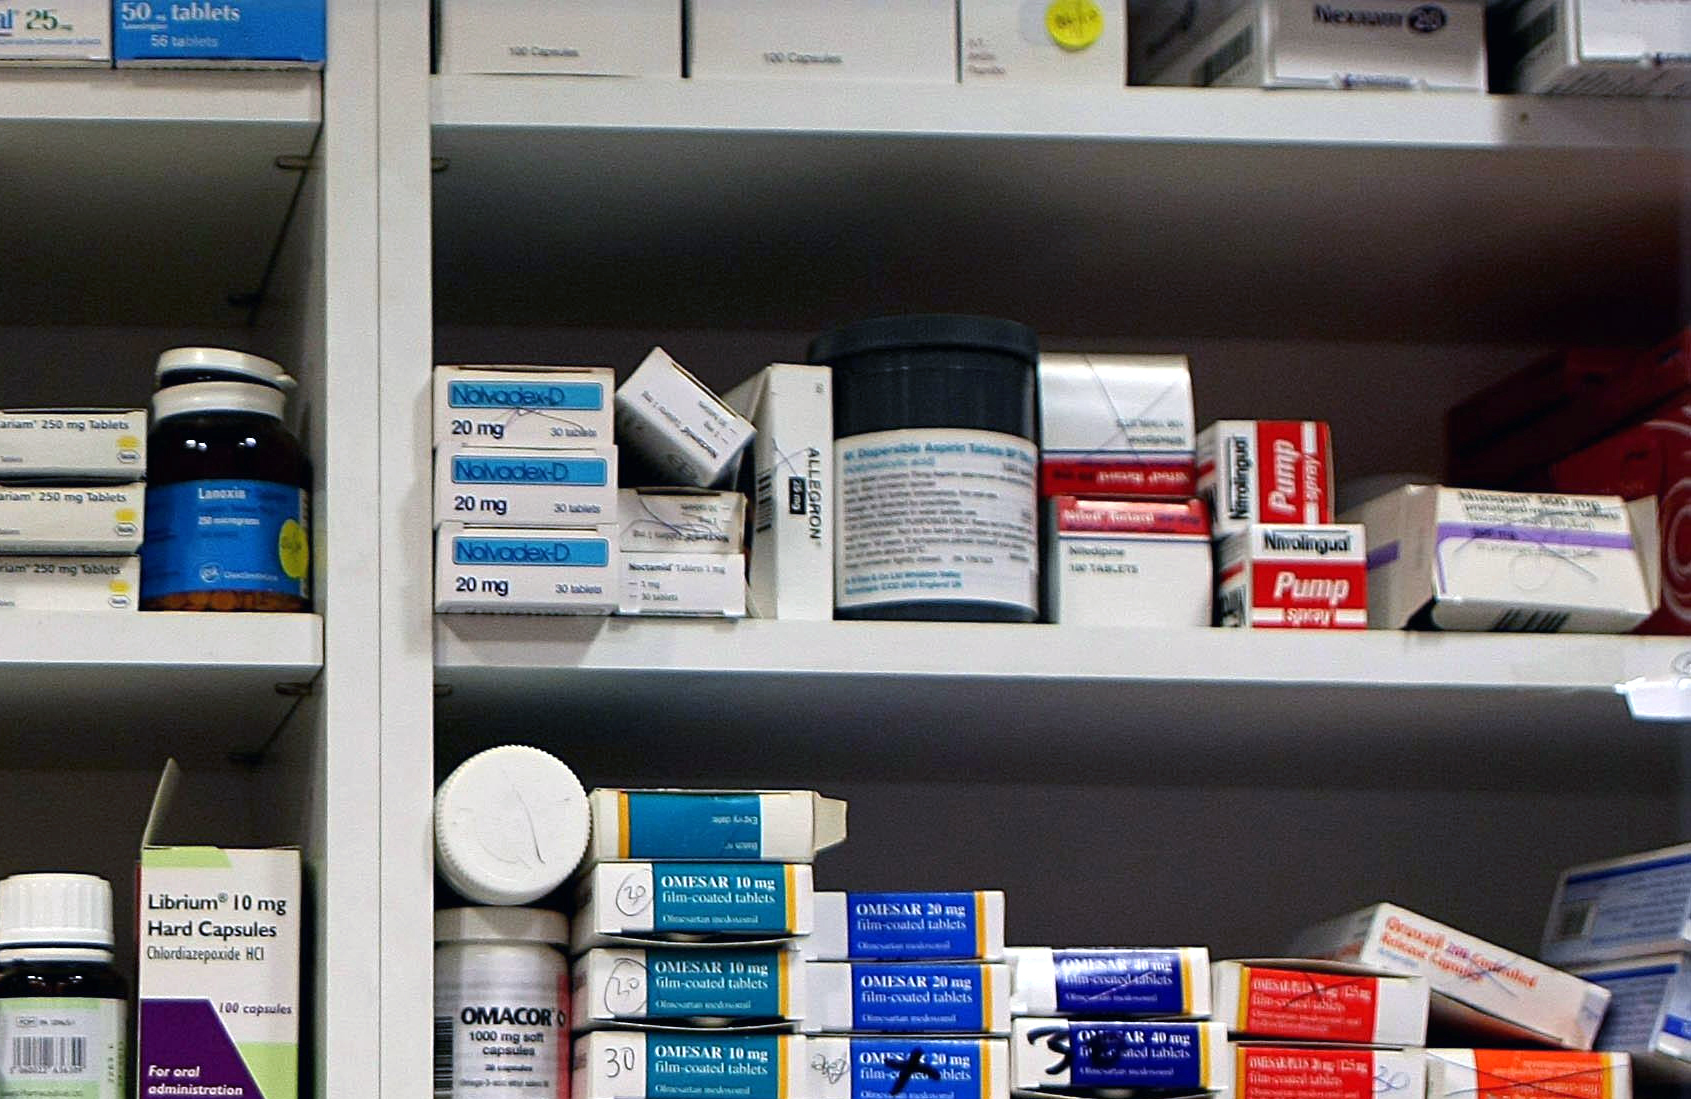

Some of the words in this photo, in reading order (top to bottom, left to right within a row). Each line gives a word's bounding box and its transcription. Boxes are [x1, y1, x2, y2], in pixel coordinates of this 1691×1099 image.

[122, 4, 152, 20] 50
[172, 4, 240, 21] tablets
[452, 387, 565, 405] Nolvadex-D
[41, 419, 61, 431] 250
[65, 421, 86, 434] mg
[89, 419, 129, 432] Tablets
[452, 420, 472, 435] 20
[477, 423, 505, 438] mg
[455, 463, 568, 481] Nolvadex-D
[1269, 440, 1296, 513] Pump
[808, 447, 821, 540] ALLEGRON
[455, 496, 476, 511] 20
[480, 499, 507, 514] mg
[555, 504, 567, 513] 30
[569, 504, 601, 513] tablets
[1274, 572, 1350, 604] Pump
[1284, 608, 1332, 626] spray
[661, 876, 729, 889] OMESAR
[736, 876, 751, 888] 10
[754, 878, 775, 892] mg
[232, 895, 252, 910] 10
[258, 898, 286, 915] mg
[663, 892, 727, 902] film-coated
[731, 891, 775, 903] tablets
[148, 920, 192, 937] Hard
[198, 921, 276, 940] Capsules
[147, 945, 240, 963] Chlordiazepoxide
[219, 1002, 240, 1013] 100
[243, 1002, 292, 1016] capsules
[461, 1007, 552, 1025] OMACOR
[469, 1032, 493, 1043] 1000
[500, 1034, 519, 1044] mg
[523, 1031, 544, 1043] soft
[483, 1046, 535, 1058] capsules
[148, 1065, 172, 1077] For
[176, 1065, 199, 1077] oral
[148, 1084, 243, 1095] administration
